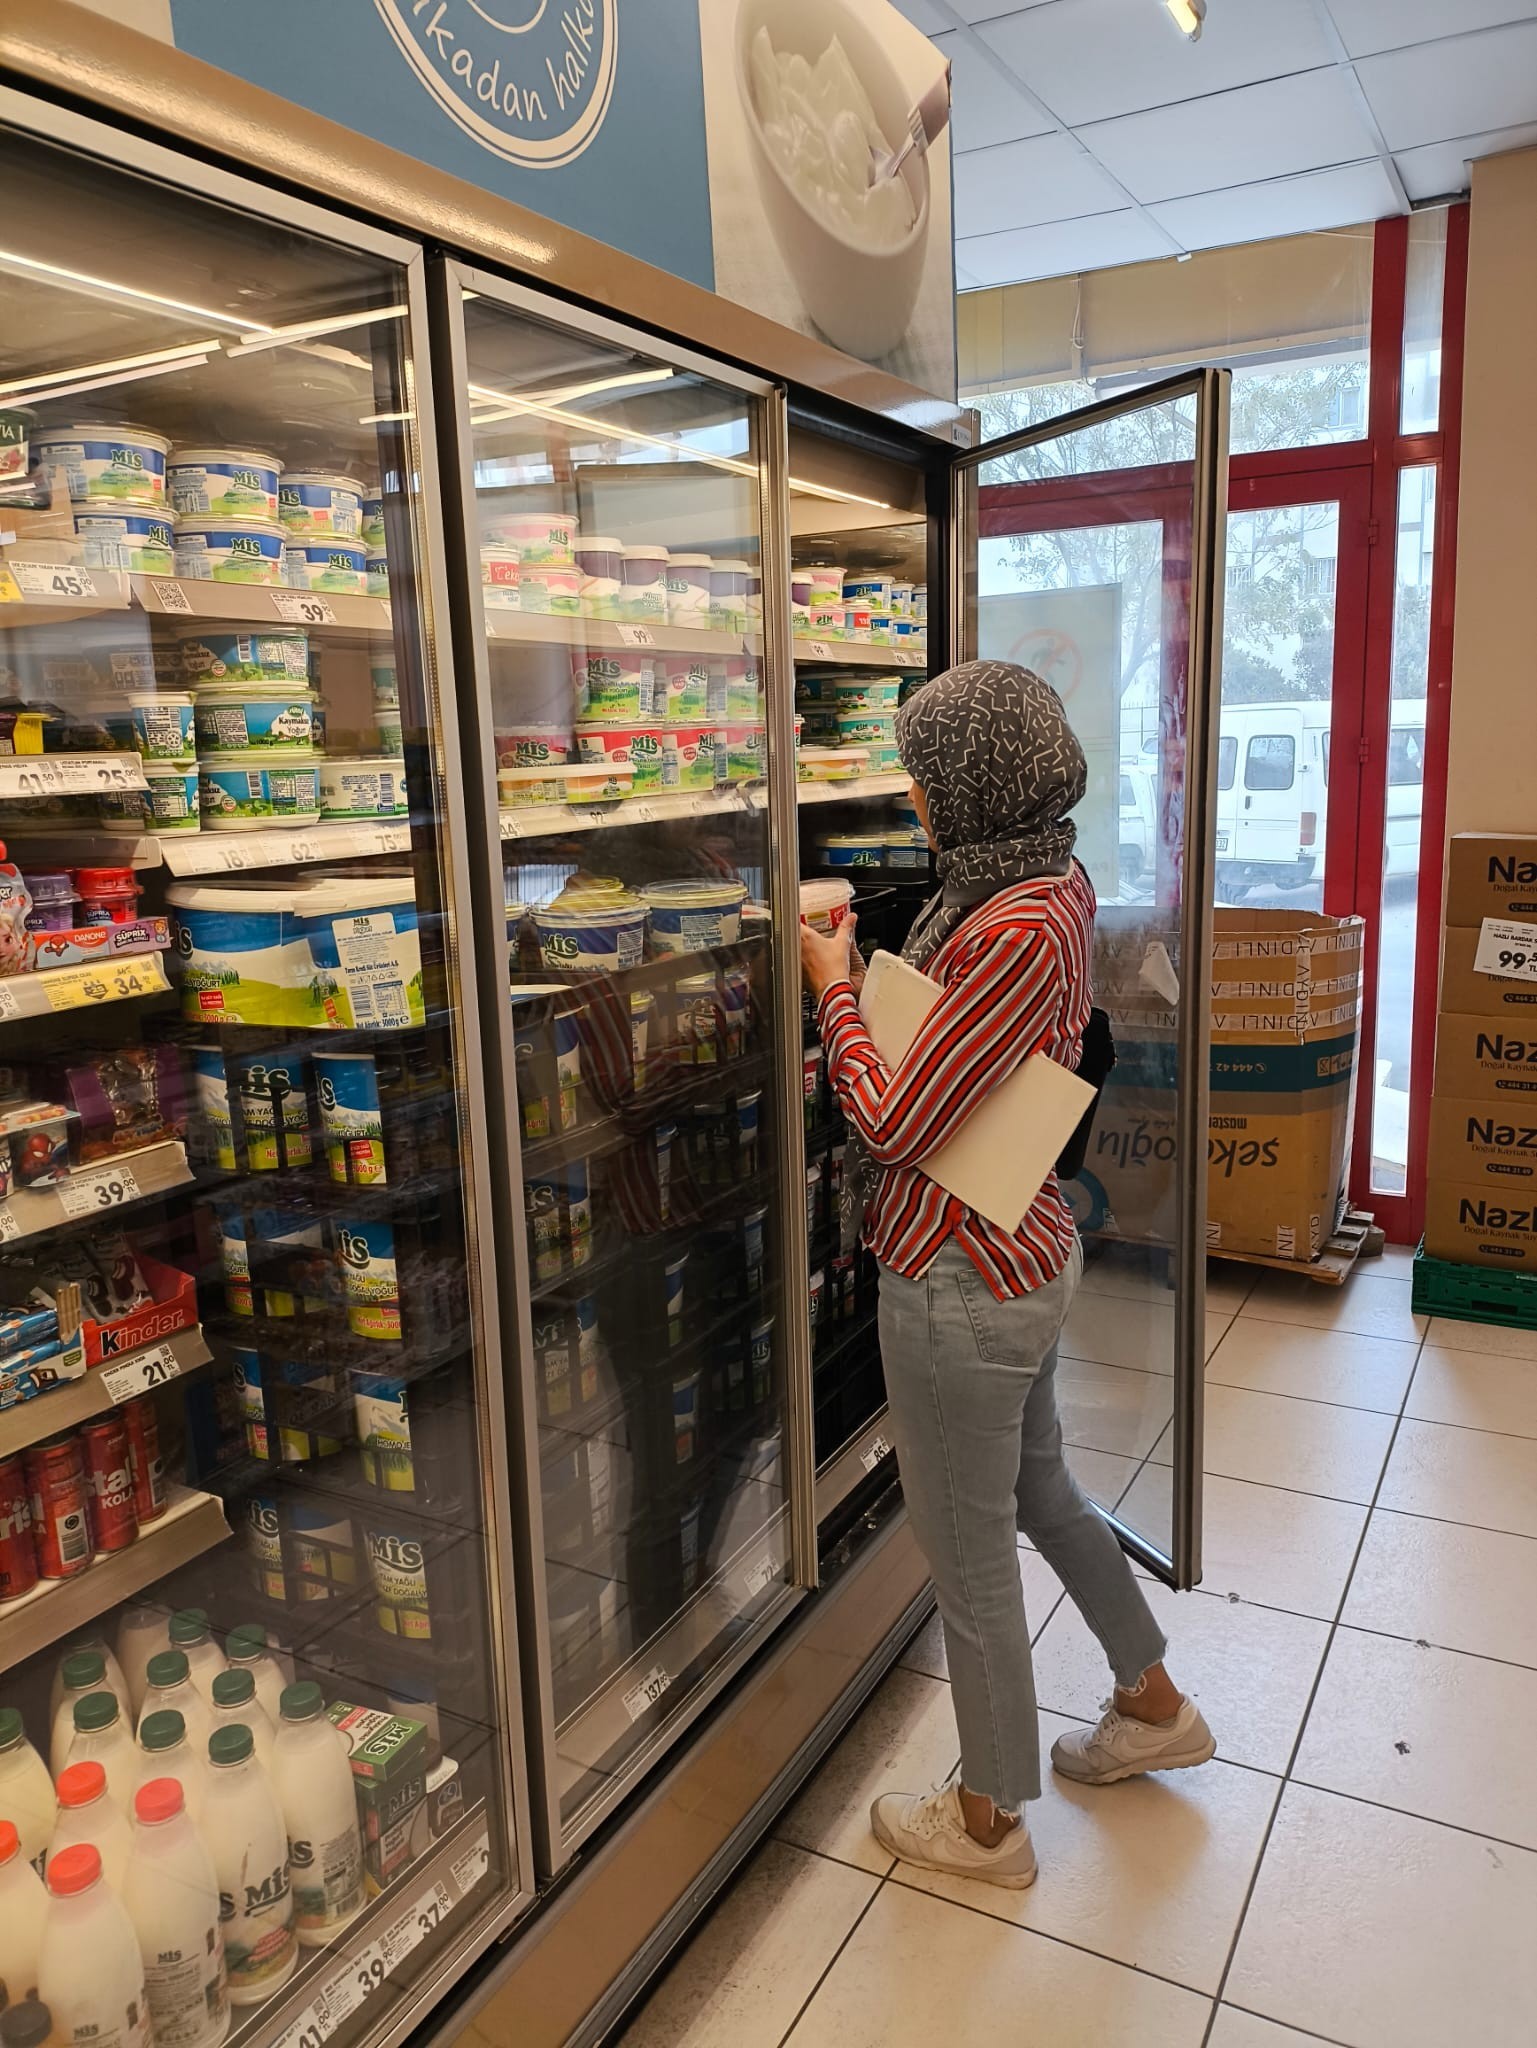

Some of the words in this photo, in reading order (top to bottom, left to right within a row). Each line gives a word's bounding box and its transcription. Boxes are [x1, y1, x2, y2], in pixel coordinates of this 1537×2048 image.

[1488, 855, 1537, 884] Na
[1476, 1033, 1537, 1063] Naz
[240, 1064, 291, 1103] is
[1466, 1116, 1537, 1149] Naz
[1460, 1198, 1537, 1233] Nazl
[339, 1229, 370, 1268] is
[101, 1310, 183, 1357] Kinder
[251, 1502, 279, 1536] is
